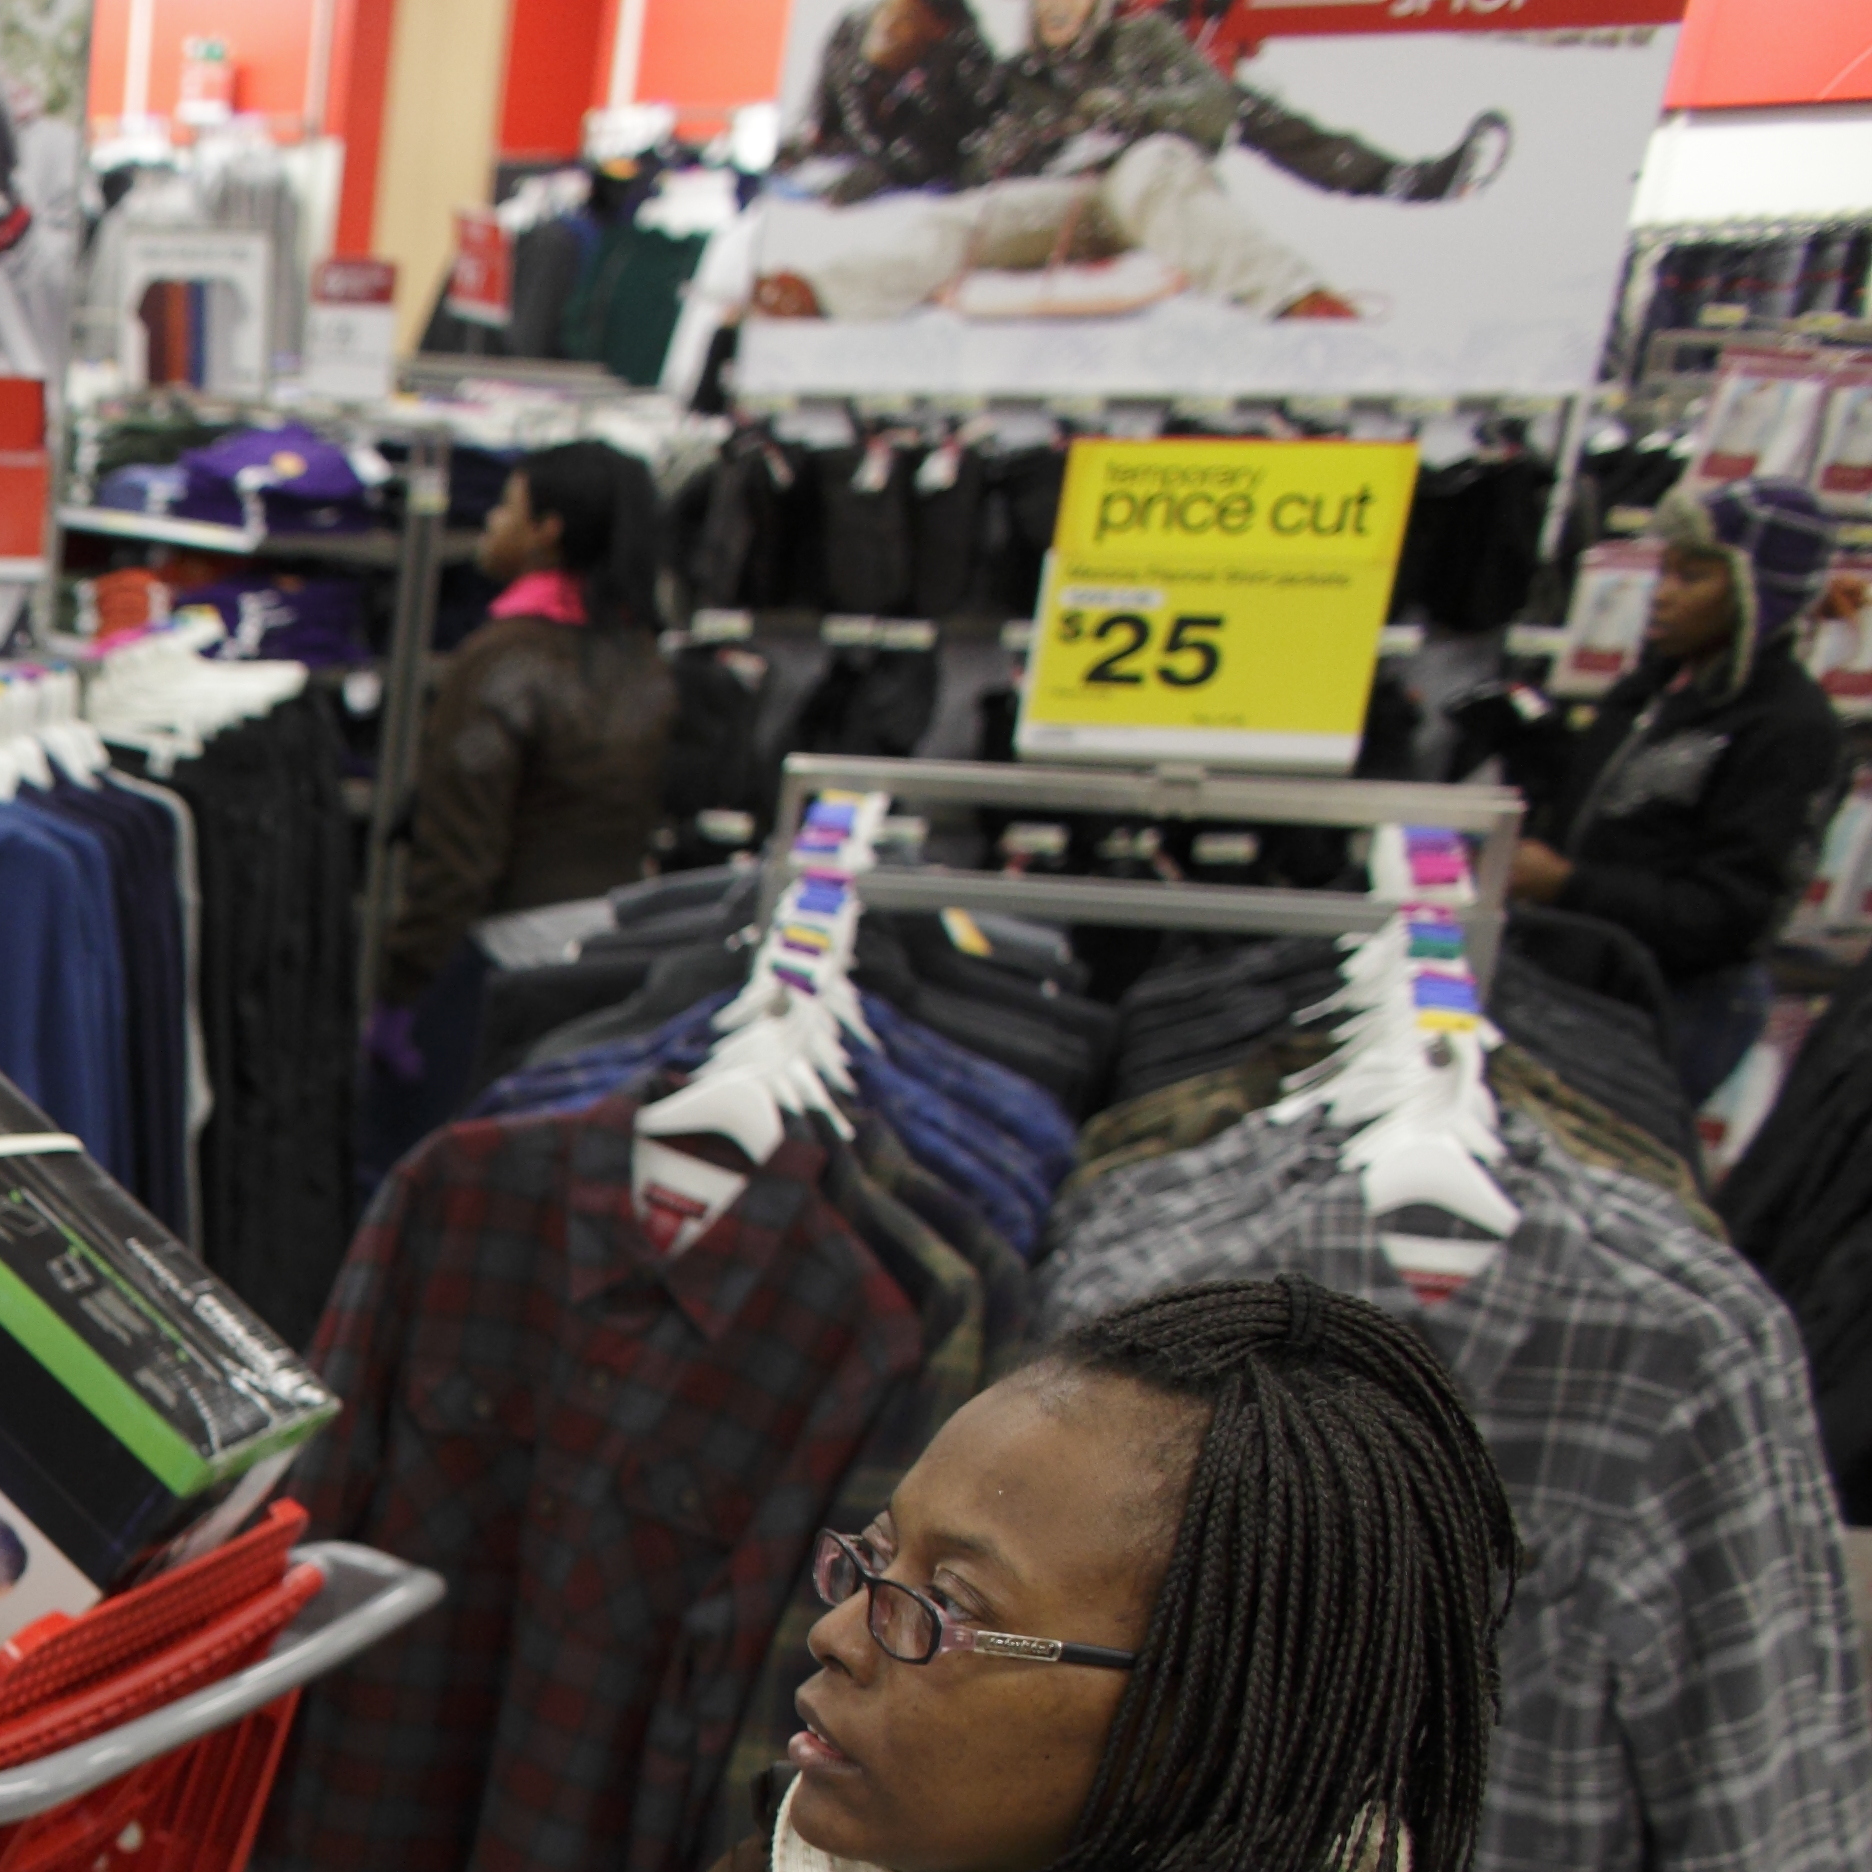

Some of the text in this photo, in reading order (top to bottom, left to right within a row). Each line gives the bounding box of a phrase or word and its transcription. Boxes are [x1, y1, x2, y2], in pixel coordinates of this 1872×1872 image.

[1105, 459, 1268, 489] temporary
[1094, 482, 1376, 546] price cut
[1059, 611, 1226, 689] $25
